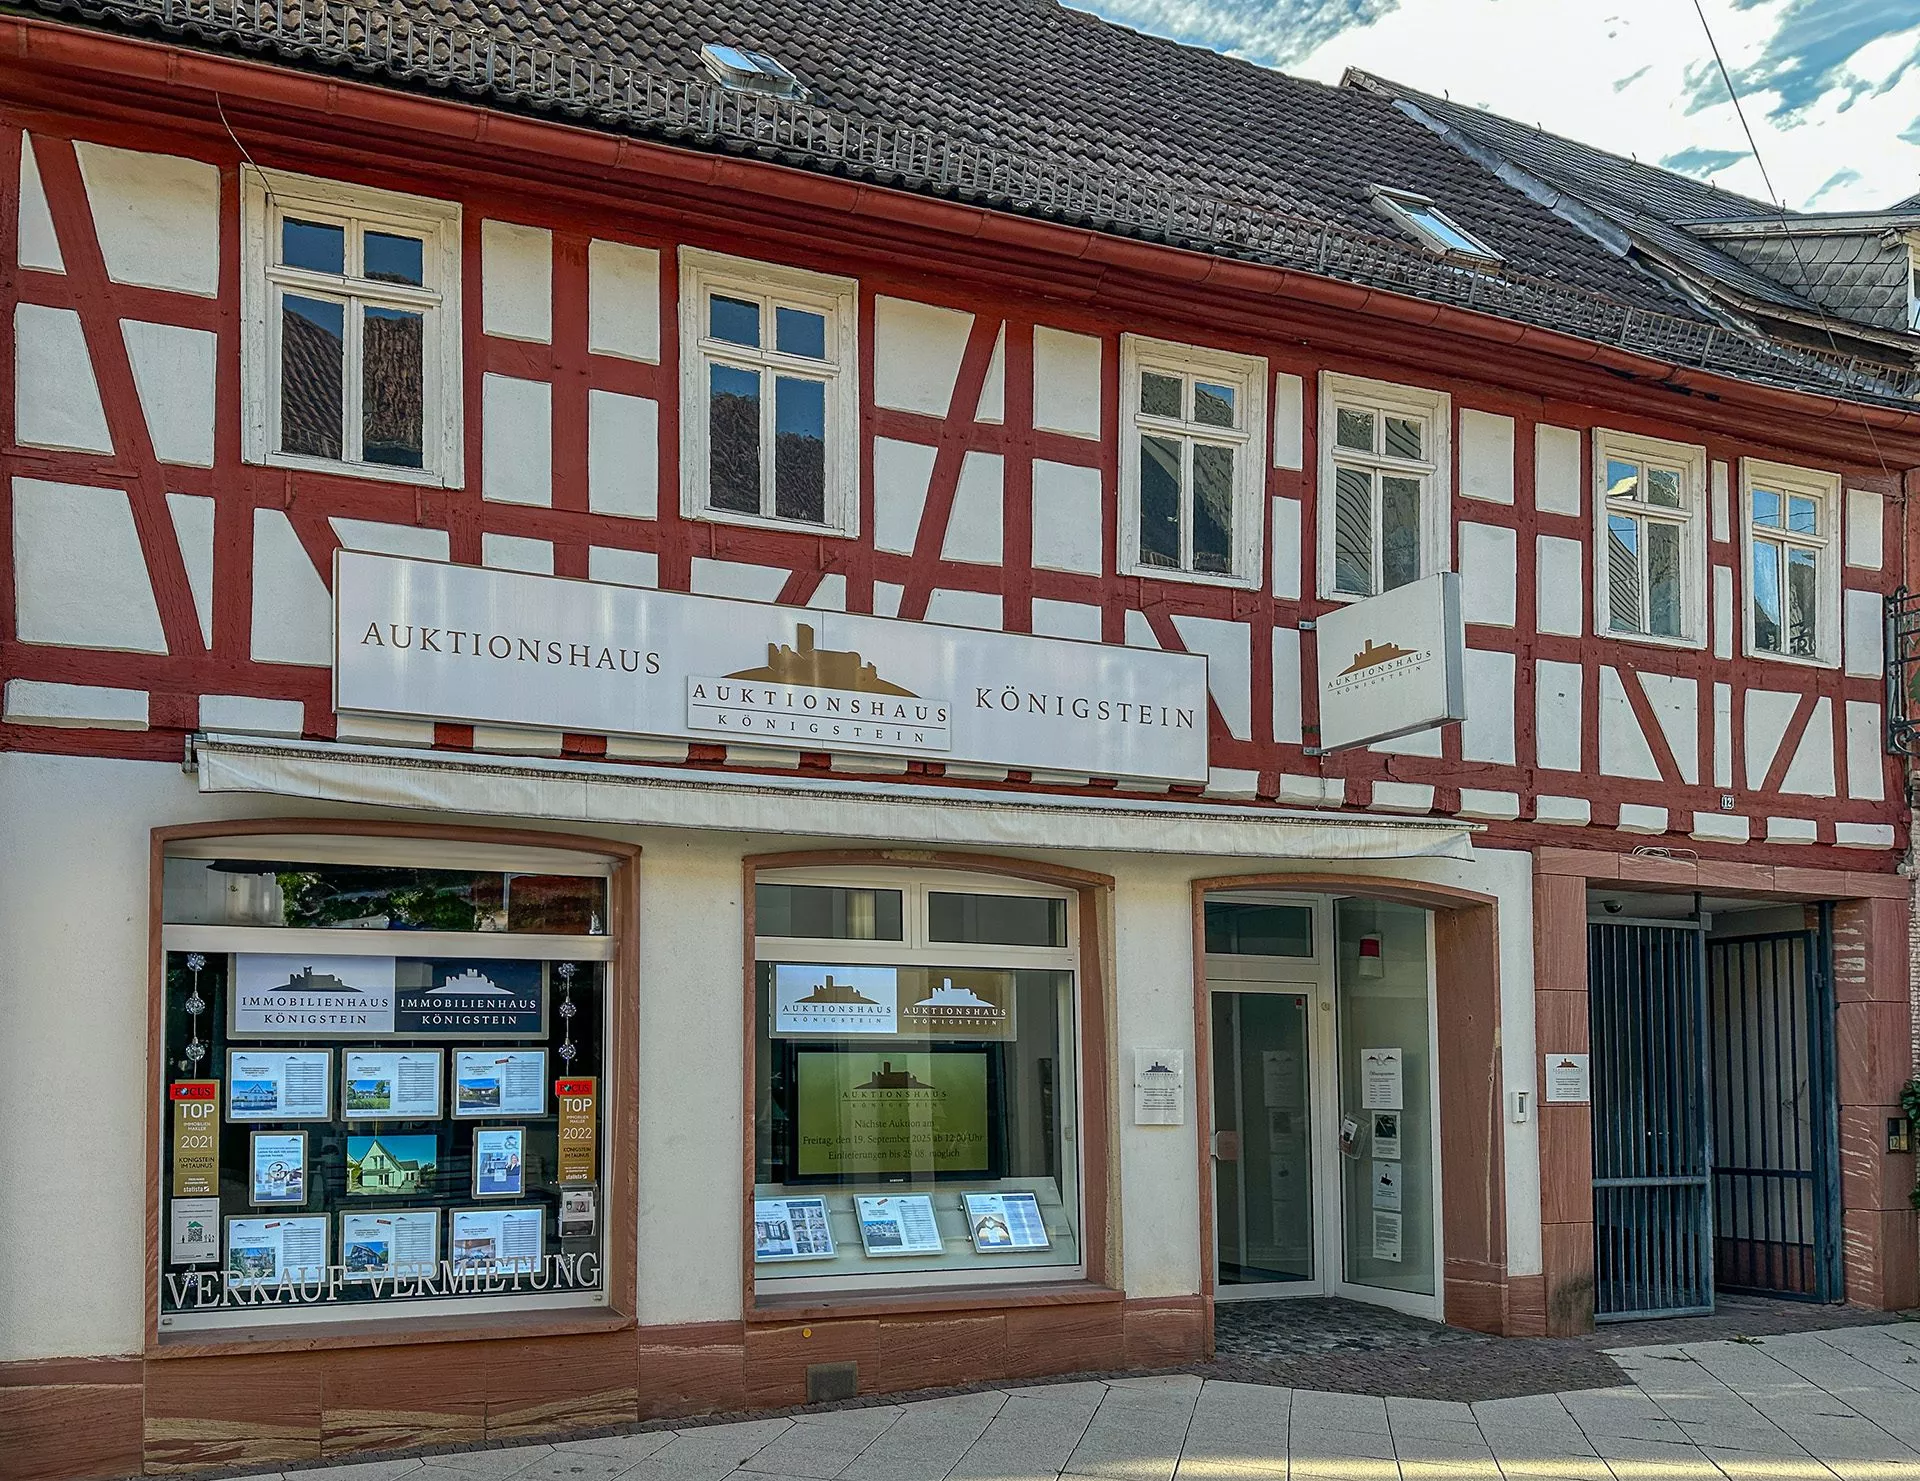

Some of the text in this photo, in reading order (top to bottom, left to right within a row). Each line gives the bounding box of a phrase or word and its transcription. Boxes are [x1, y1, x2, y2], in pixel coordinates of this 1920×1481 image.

[361, 622, 660, 674] AUKTIONSHAUS
[1327, 650, 1432, 689] AUKTIONSHAUS
[1336, 666, 1421, 695] KÖNIGSTEIN
[692, 683, 947, 722] AUKTIONSHAUS
[975, 684, 1195, 729] KÖNIGSTEIN
[717, 713, 925, 744] KÖNIGSTEIN
[1724, 797, 1732, 807] 12
[242, 996, 389, 1007] IMMOBILIENHAUS
[401, 998, 536, 1009] IMMOBILIENHAUS
[782, 1004, 892, 1014] AUKTIONSHAUS
[903, 1007, 1007, 1016] AUKTIONSHAUS
[264, 1012, 367, 1024] KÖNIGSTEIN
[422, 1013, 517, 1025] KÖNIGSTEIN
[180, 1104, 215, 1118] TOP
[563, 1099, 592, 1112] TOP
[855, 1120, 886, 1129] Nächste
[889, 1119, 921, 1128] Auktion
[563, 1127, 592, 1139] 2022
[181, 1135, 213, 1148] 2021
[803, 1136, 833, 1146] Freitag,
[836, 1135, 851, 1144] den
[867, 1135, 910, 1145] September
[912, 1134, 931, 1143] 2025
[934, 1134, 943, 1142] ab
[945, 1134, 966, 1143] 12:00
[968, 1134, 983, 1142] Uhr
[828, 1149, 887, 1161] Einlieferungen
[889, 1149, 901, 1159] bis
